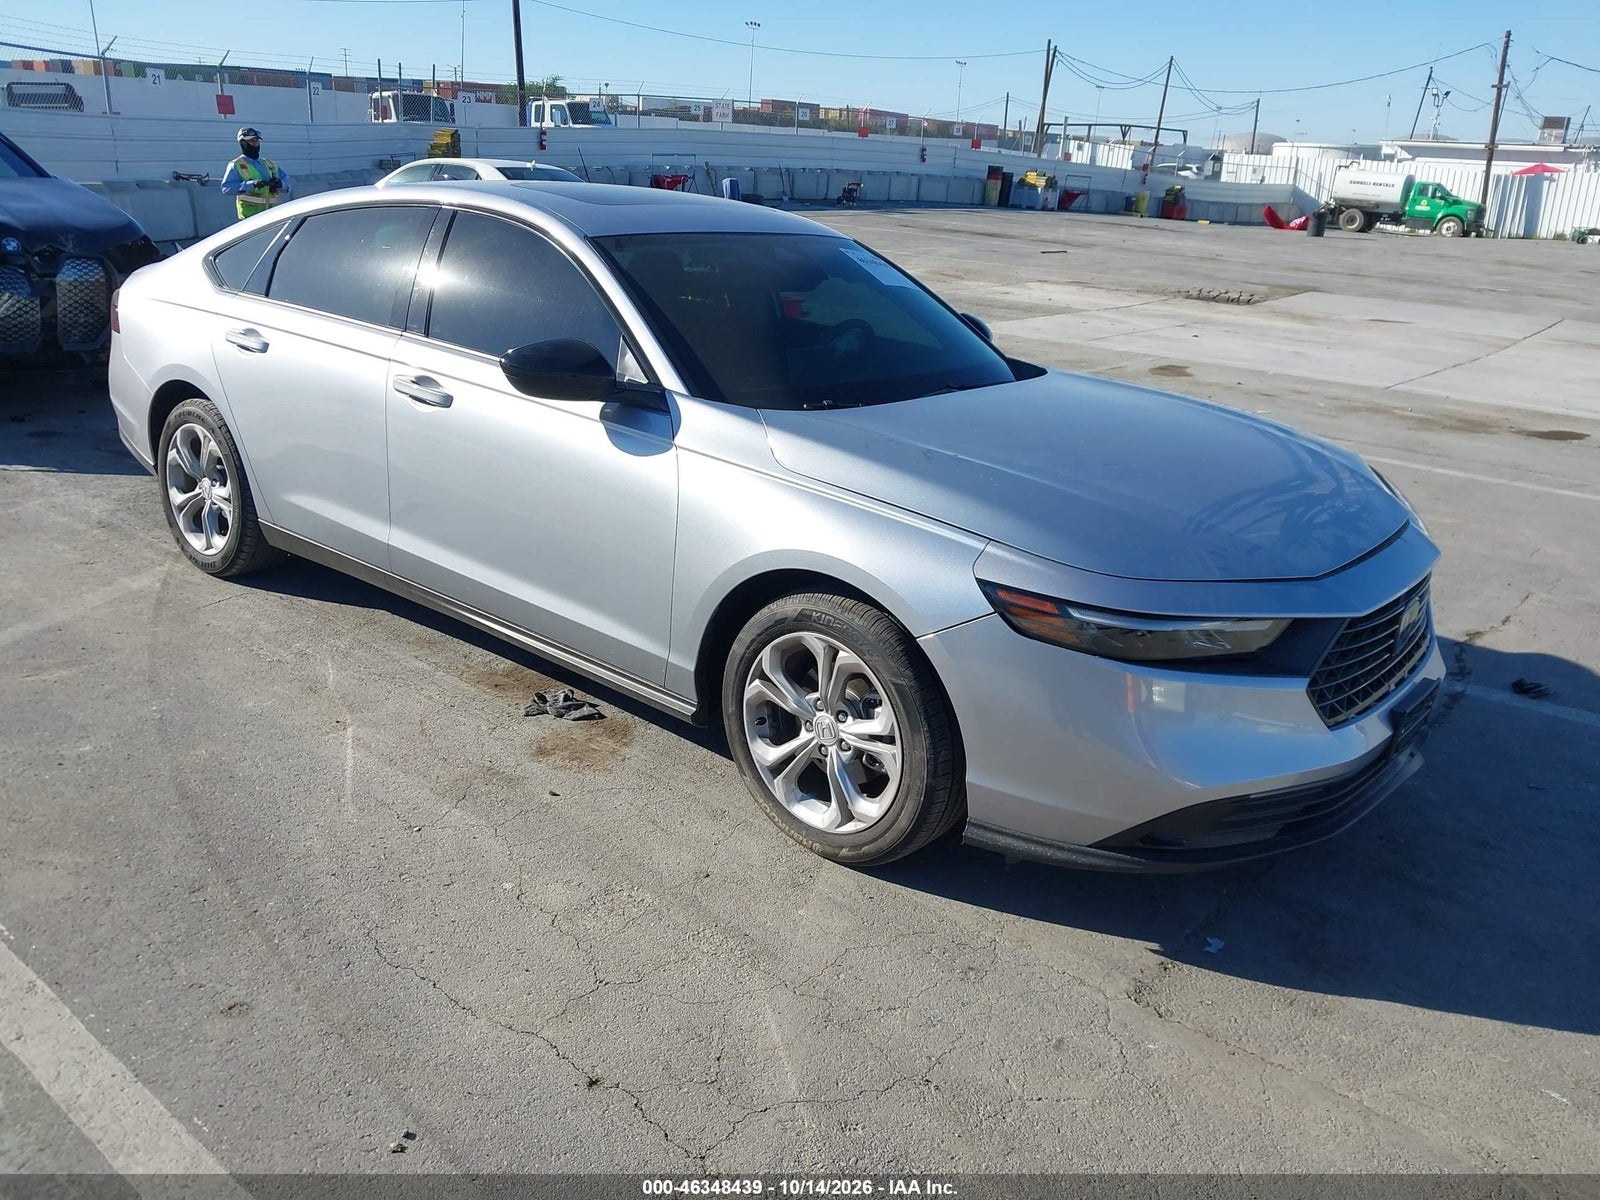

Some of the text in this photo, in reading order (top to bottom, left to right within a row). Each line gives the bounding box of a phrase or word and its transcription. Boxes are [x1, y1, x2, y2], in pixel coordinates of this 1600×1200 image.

[151, 74, 161, 85] 21
[312, 86, 320, 96] 22
[462, 95, 472, 104] 23
[693, 104, 702, 112] 25
[715, 102, 731, 110] STATE
